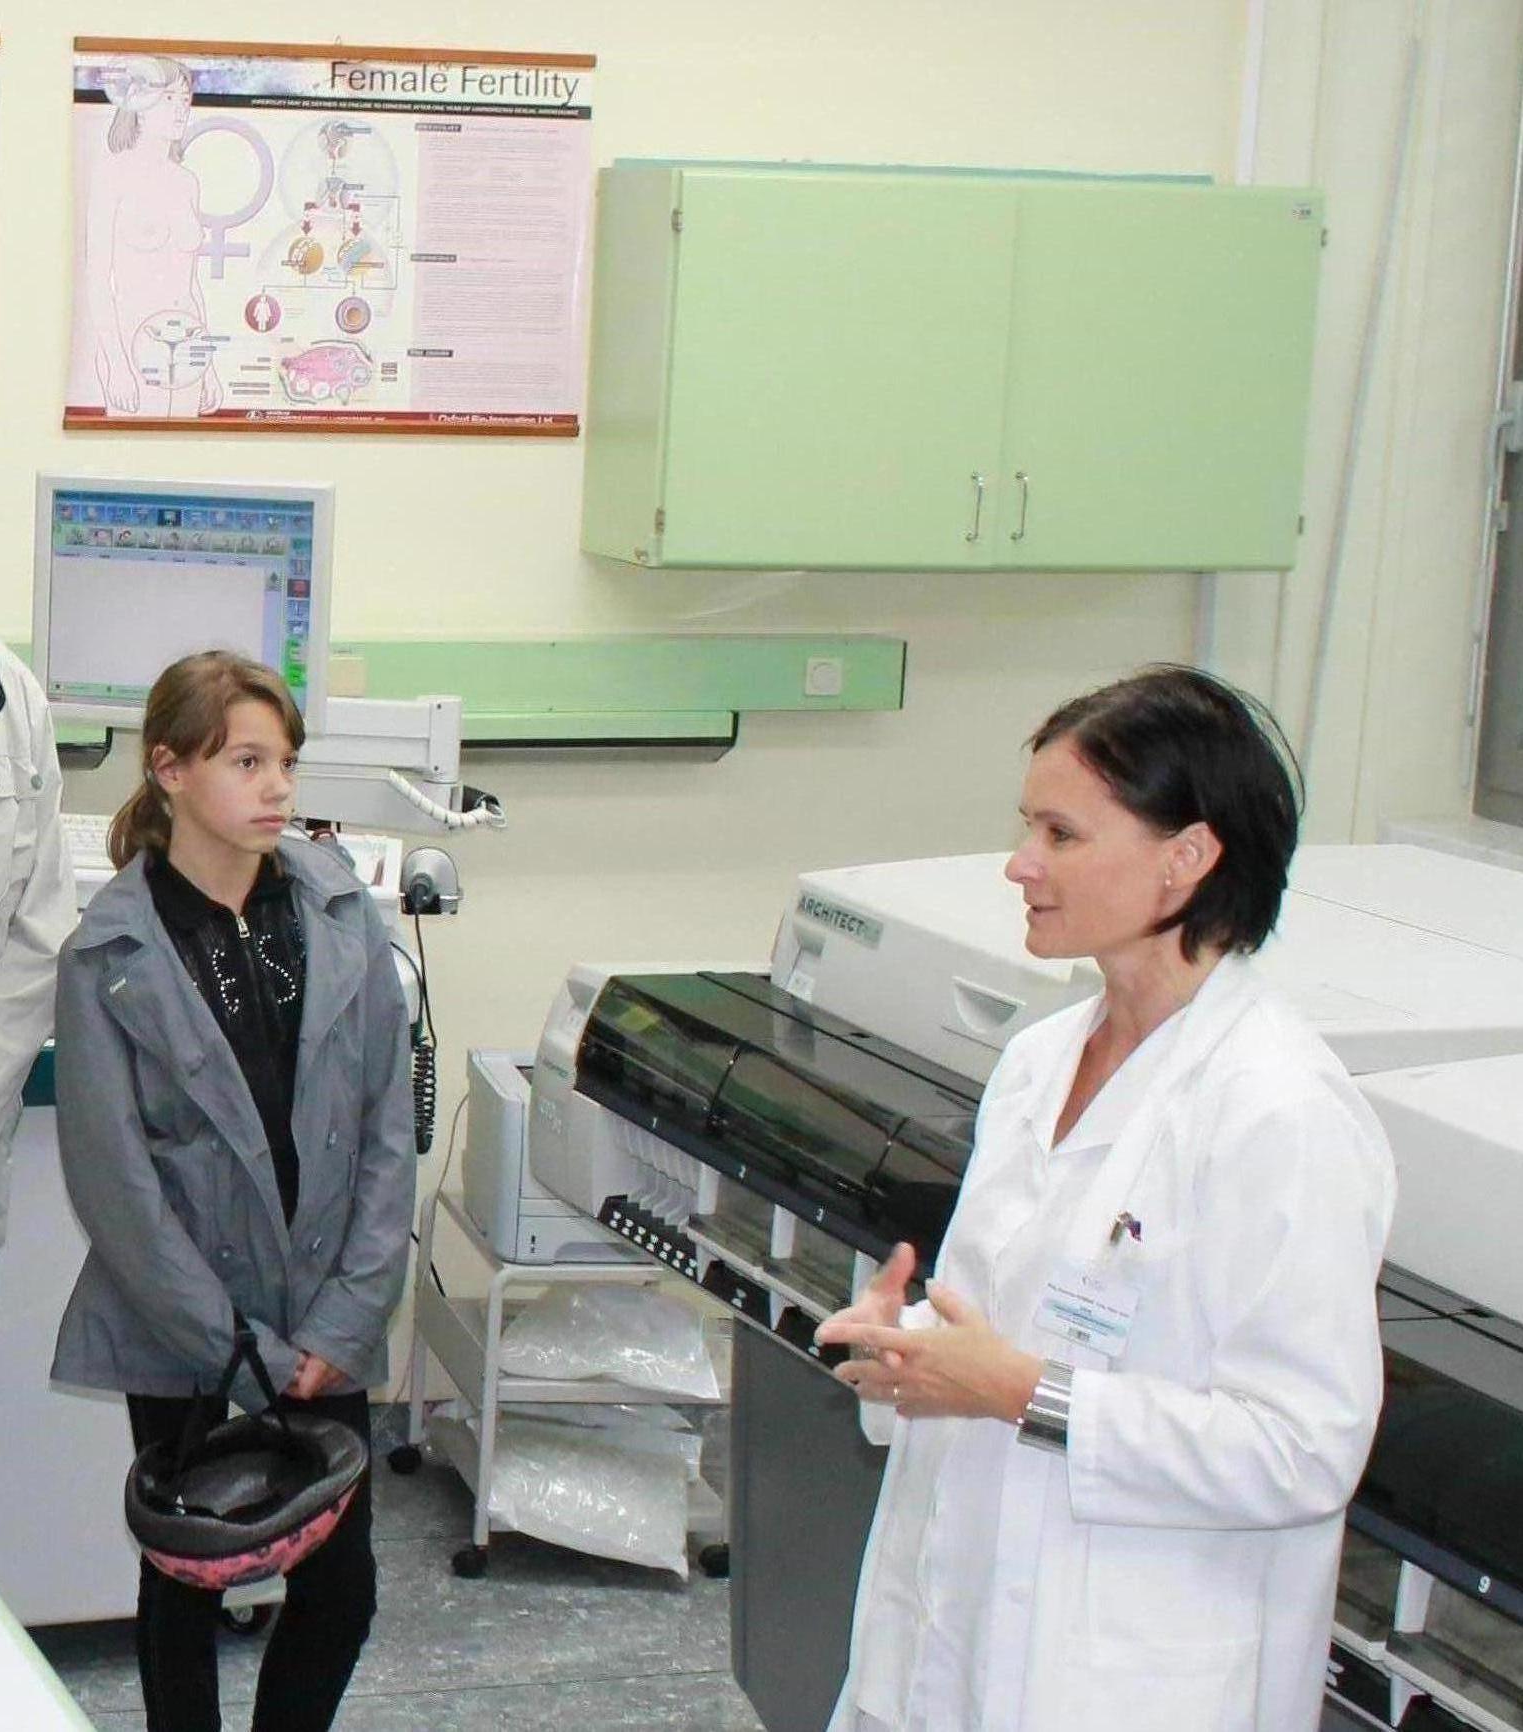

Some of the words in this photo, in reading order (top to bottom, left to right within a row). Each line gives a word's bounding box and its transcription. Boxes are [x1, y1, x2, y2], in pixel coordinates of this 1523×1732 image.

[330, 60, 449, 94] Female
[461, 65, 580, 106] Fertility
[797, 895, 865, 936] ARCHITECT
[1477, 1574, 1492, 1594] 9
